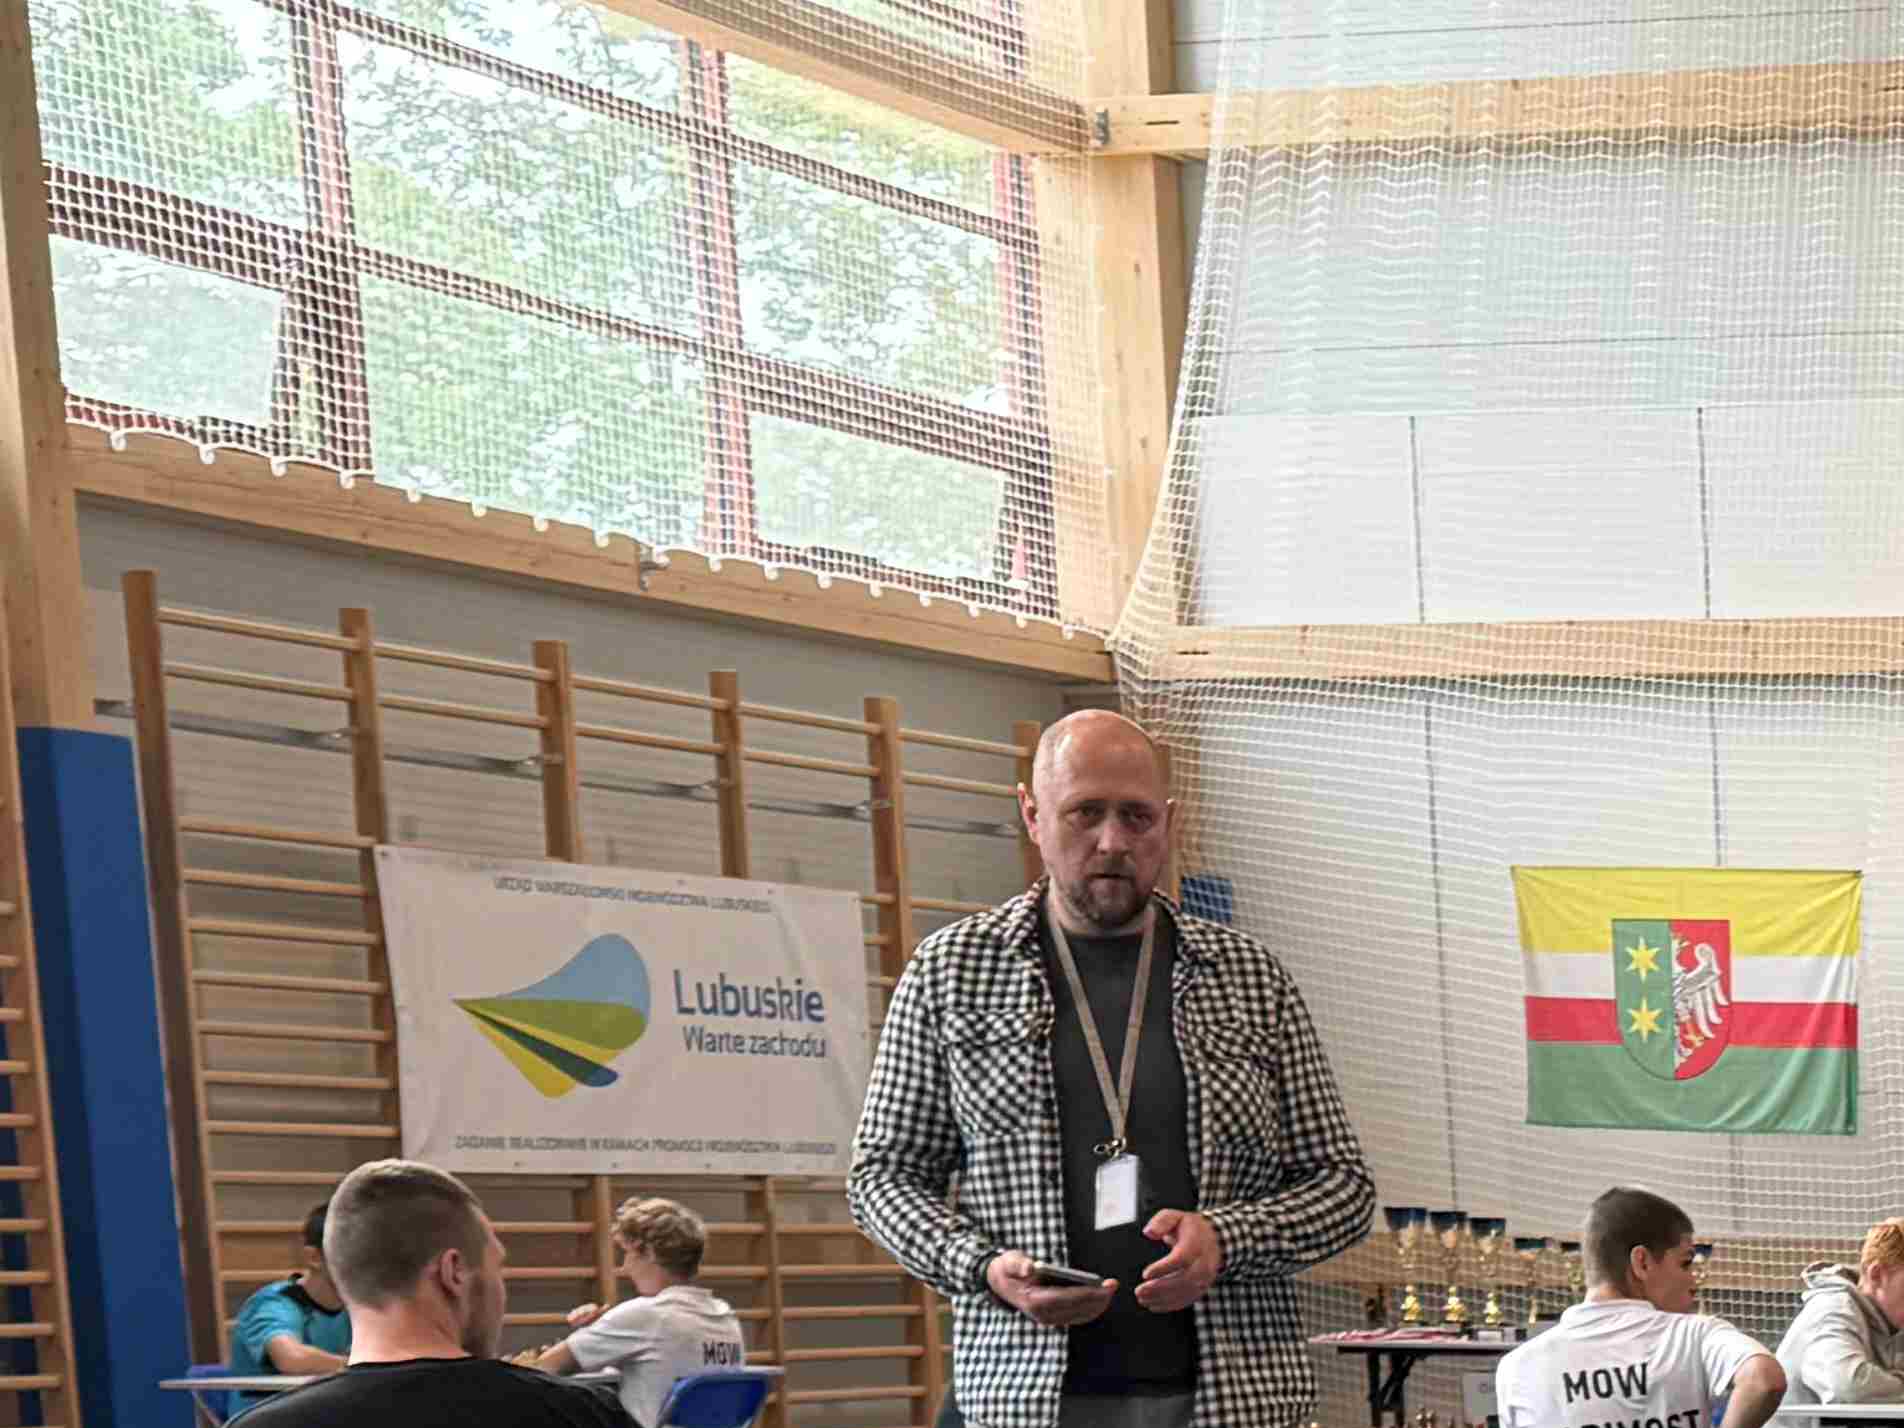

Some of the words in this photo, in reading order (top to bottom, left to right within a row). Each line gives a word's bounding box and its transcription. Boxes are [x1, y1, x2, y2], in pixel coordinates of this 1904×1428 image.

[673, 969, 825, 1022] Lubuskie
[683, 1025, 745, 1053] Warte
[748, 1030, 825, 1057] zachodu
[1563, 1362, 1648, 1402] MOW
